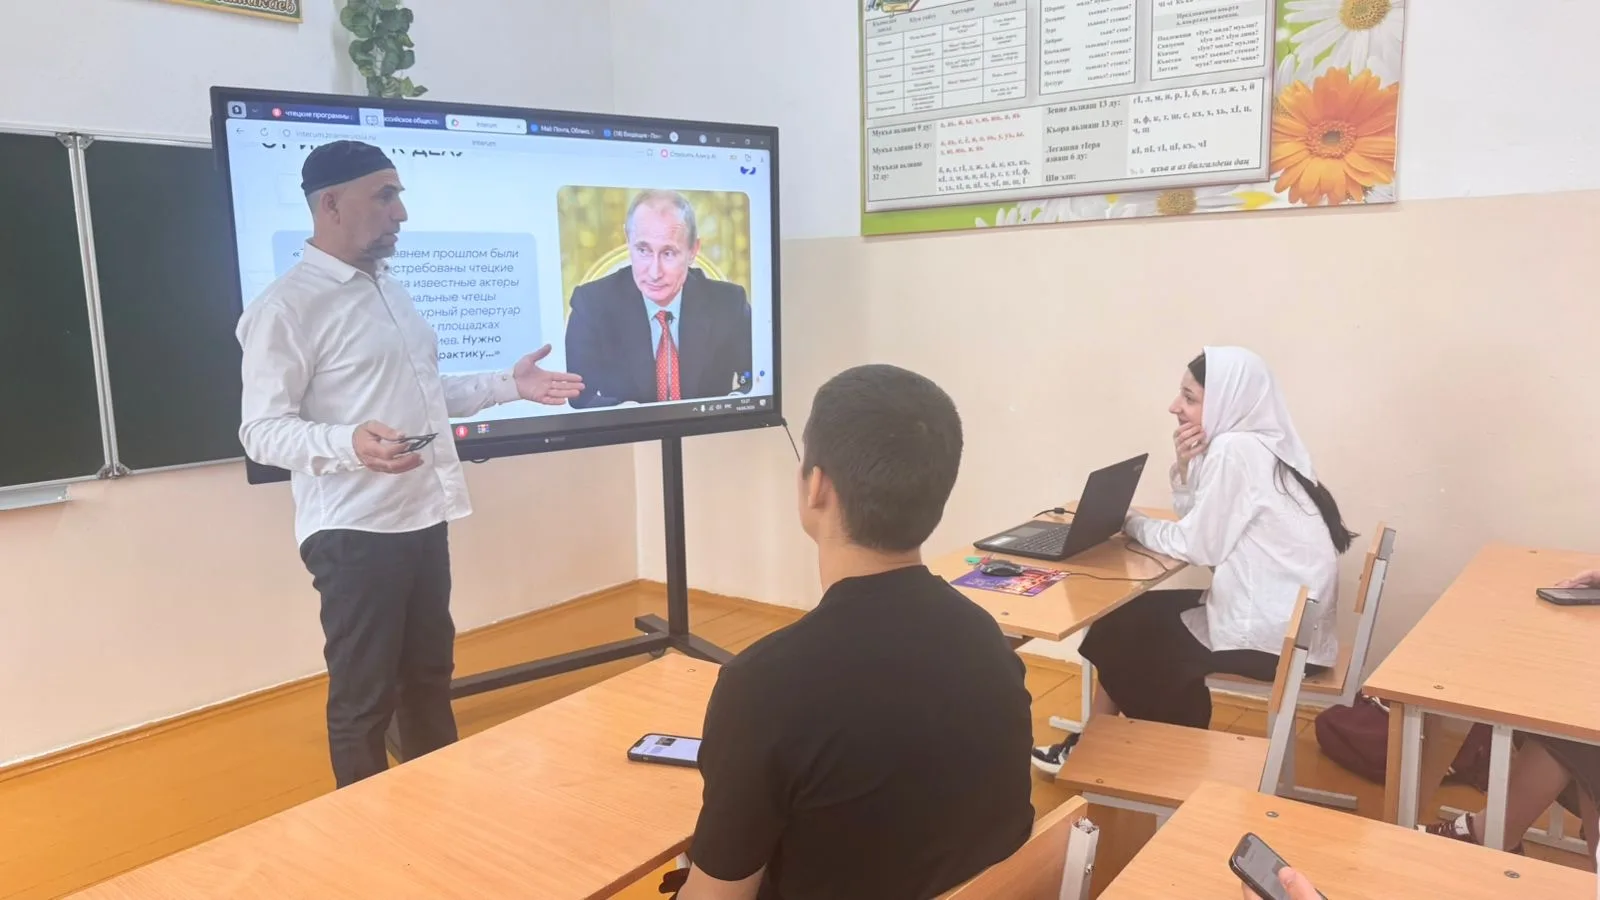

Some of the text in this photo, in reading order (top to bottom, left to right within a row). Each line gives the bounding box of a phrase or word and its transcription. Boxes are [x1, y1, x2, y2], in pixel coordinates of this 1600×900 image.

[392, 248, 519, 260] авнем прошлом были
[392, 262, 514, 275] стребованы чтецкие
[414, 278, 476, 288] известные
[479, 278, 519, 290] актеры
[462, 293, 496, 303] чтецы
[420, 305, 521, 318] урный репертуар
[438, 321, 499, 331] площадках
[463, 334, 501, 346] Нужно
[438, 350, 500, 361] рактику...»
